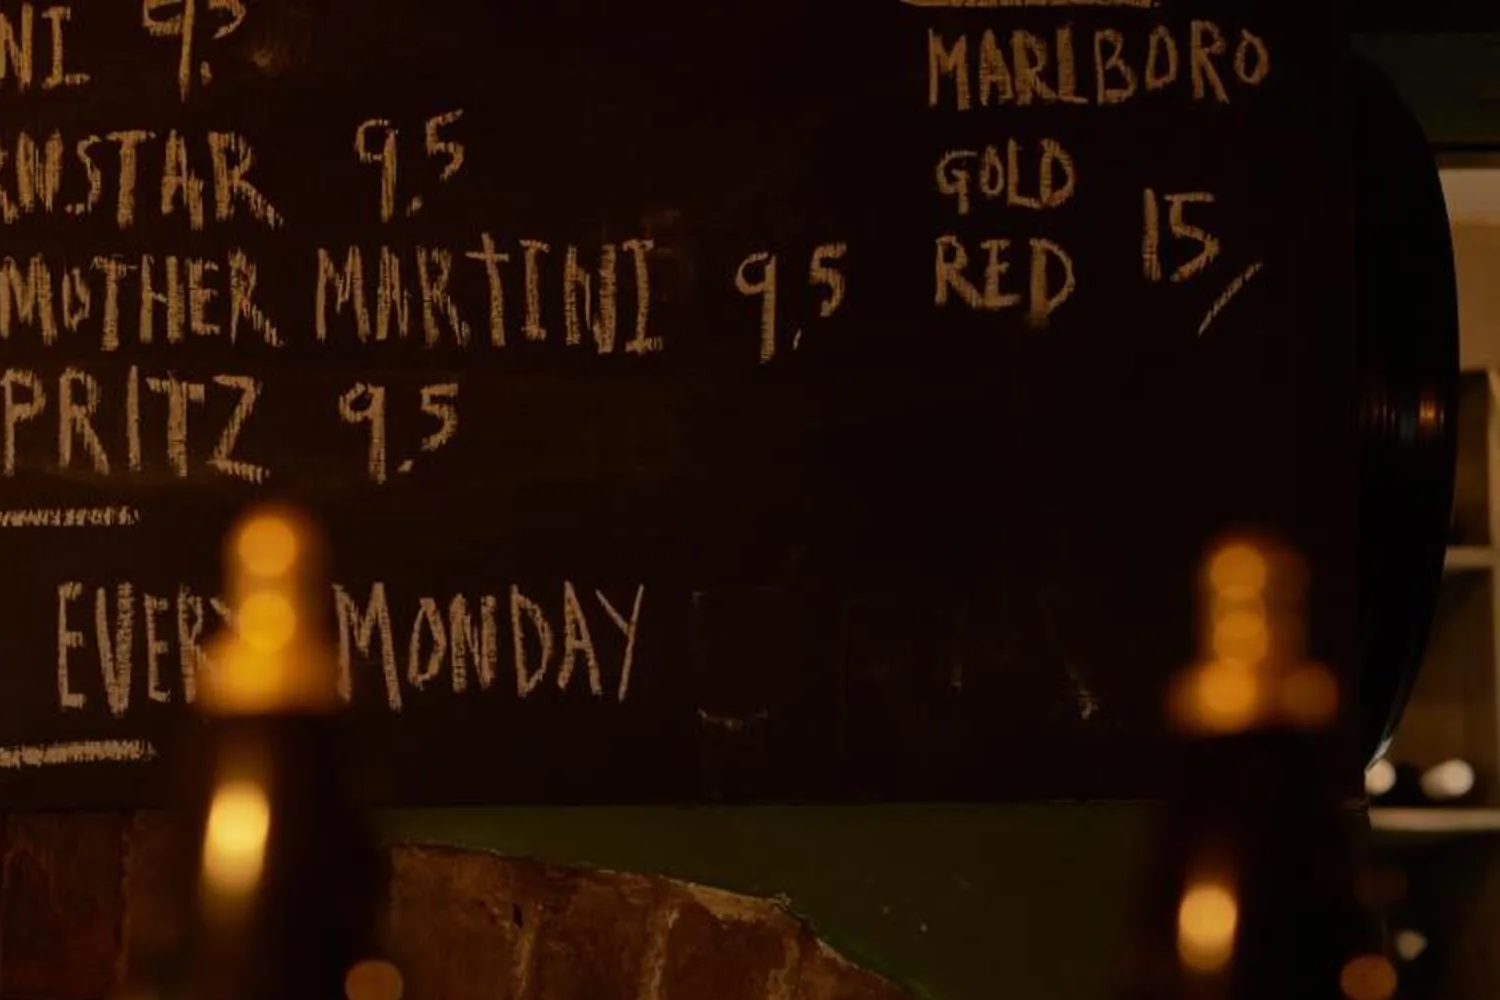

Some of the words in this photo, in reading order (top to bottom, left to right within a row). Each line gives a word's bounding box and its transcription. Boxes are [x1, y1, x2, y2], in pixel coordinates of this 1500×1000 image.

[929, 19, 1269, 110] MARLBORO
[355, 109, 464, 222] 9.5
[936, 139, 1076, 213] GOLD
[315, 232, 661, 355] MARTINI
[734, 243, 847, 362] 9.5
[934, 235, 1076, 326] RED
[339, 382, 459, 484] 9.5
[338, 580, 644, 711] MONDAY
